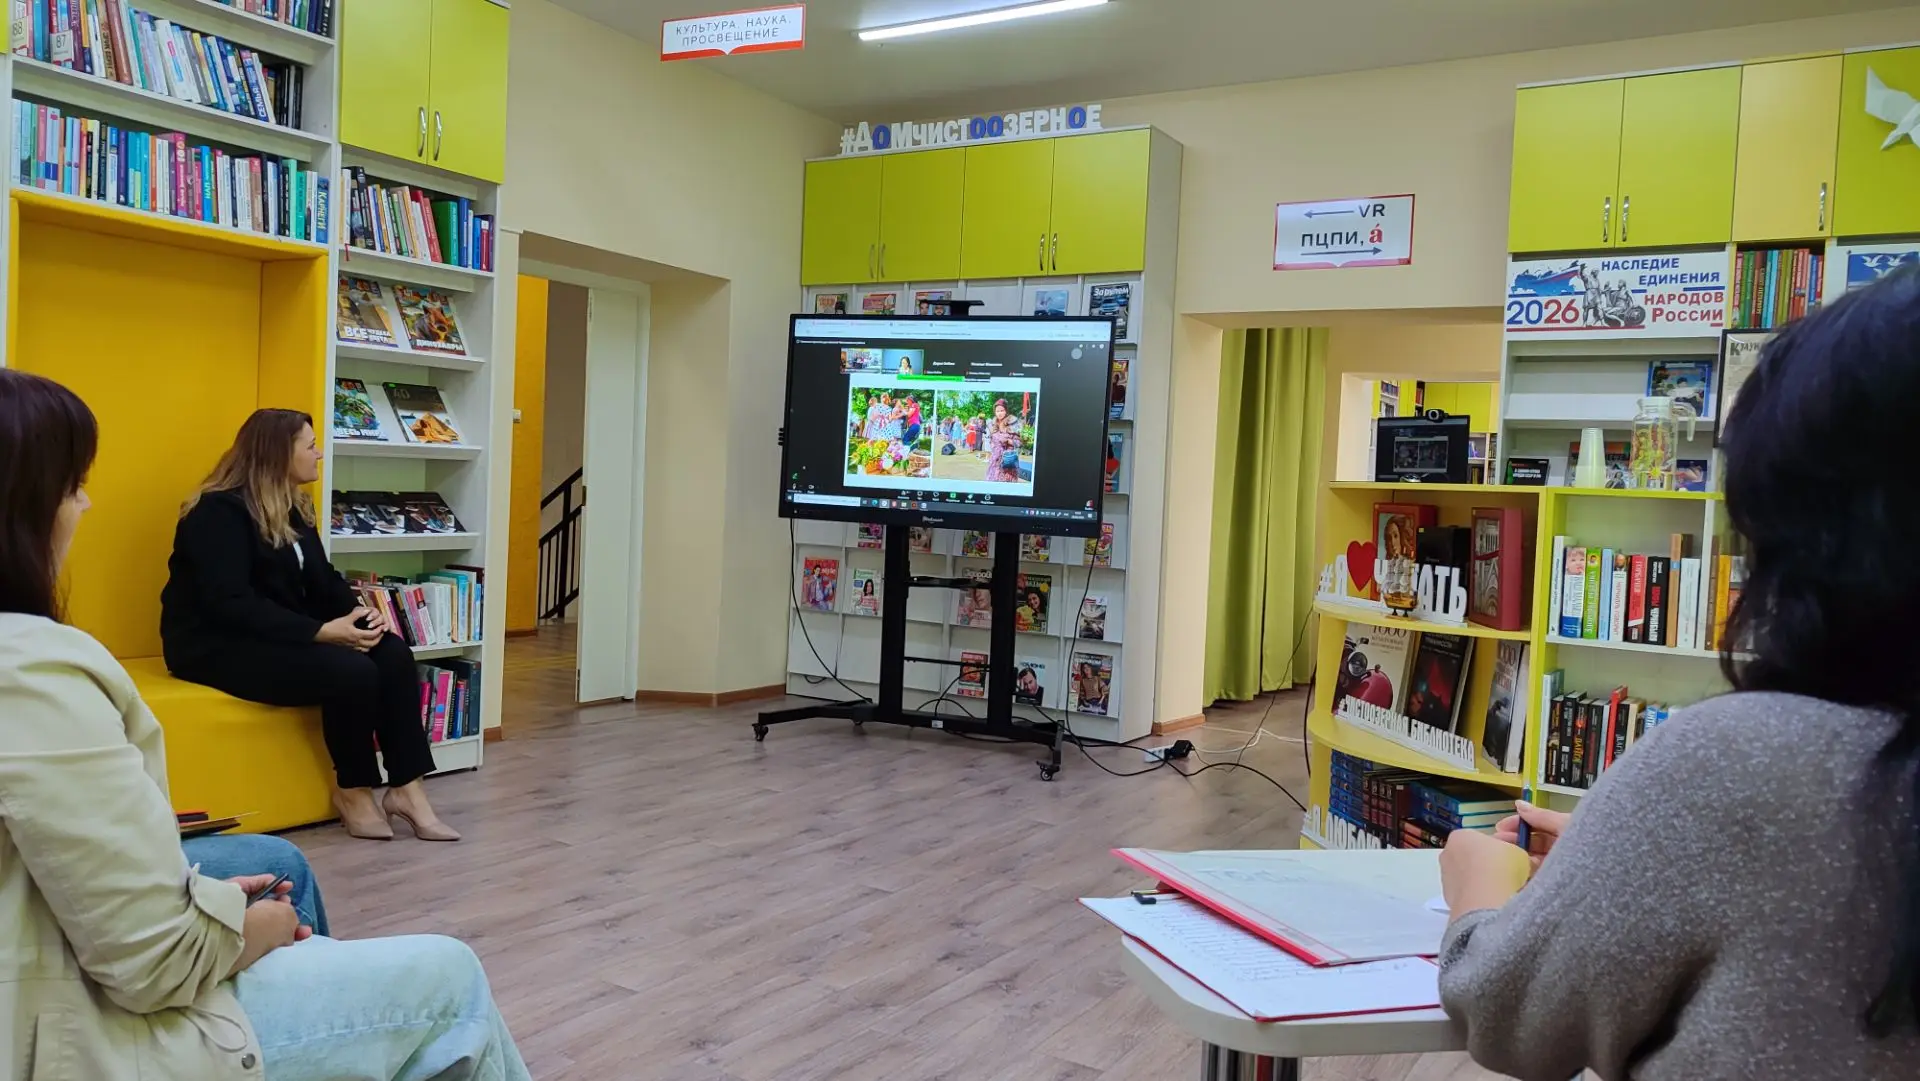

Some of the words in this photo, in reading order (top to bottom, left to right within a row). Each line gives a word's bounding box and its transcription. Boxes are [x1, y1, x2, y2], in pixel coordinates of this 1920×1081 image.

[682, 28, 779, 46] ПРОСВЕЩЕНИЕ
[1358, 203, 1386, 218] VR
[1601, 257, 1680, 271] НАСЛЕДИЕ
[1638, 271, 1720, 286] ЕДИНЕНИЯ
[1644, 291, 1724, 306] НАРОДОВ
[1506, 299, 1580, 325] 2026
